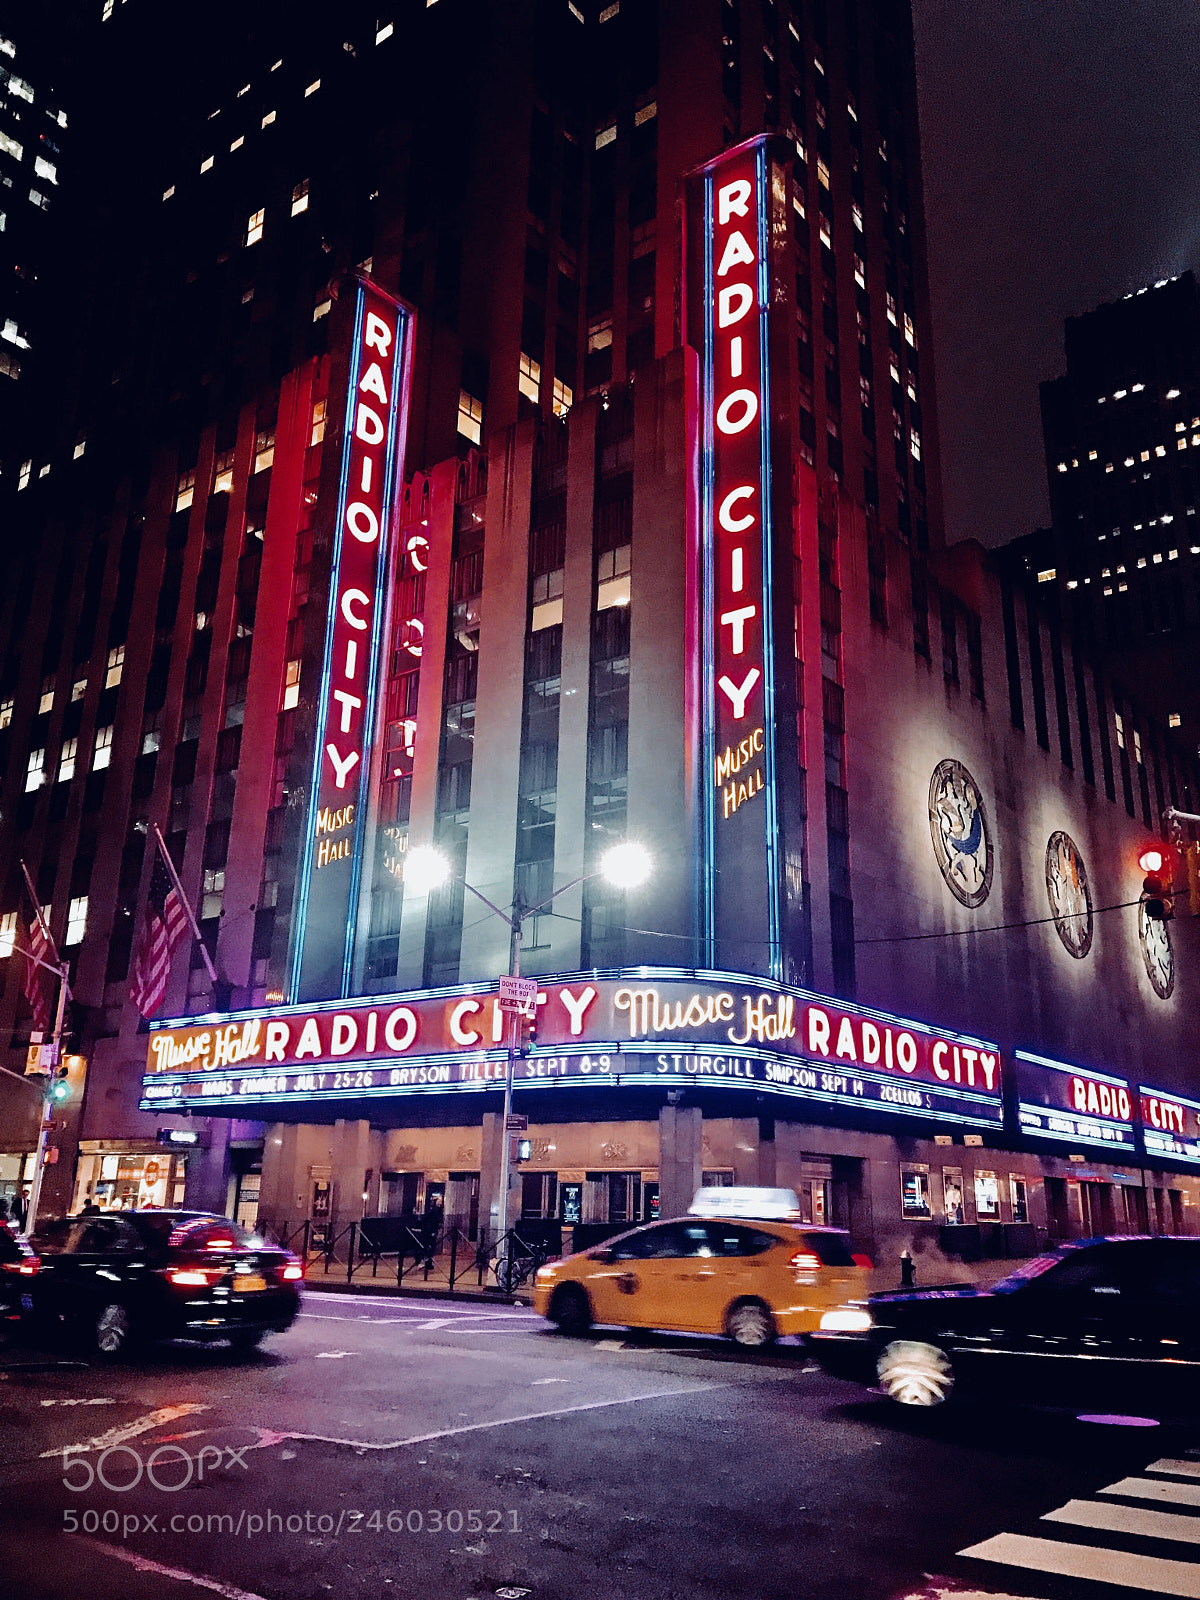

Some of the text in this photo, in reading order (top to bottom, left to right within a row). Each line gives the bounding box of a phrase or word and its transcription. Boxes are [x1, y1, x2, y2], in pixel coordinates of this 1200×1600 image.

[716, 179, 761, 720] RADIO CITY
[326, 312, 392, 789] RADIO CITY
[519, 982, 535, 991] BLOCK
[265, 1006, 418, 1063] RADIO
[614, 988, 797, 1045] Music Hall
[151, 1018, 262, 1073] Music Hall
[293, 1073, 326, 1091] JULY
[333, 1070, 373, 1089] 25-26
[389, 1064, 450, 1086] BRYSON
[526, 1057, 568, 1077] SEPT
[579, 1055, 611, 1074] 8-9
[808, 1007, 996, 1090] RADIO CITY
[656, 1054, 755, 1078] STURGILL
[765, 1062, 816, 1089] SIMPSON
[820, 1073, 847, 1094] SEPT
[853, 1079, 864, 1096] 14
[880, 1085, 922, 1107] 2CELLOS
[1072, 1077, 1131, 1121] RADIO
[1150, 1098, 1184, 1133] CITY
